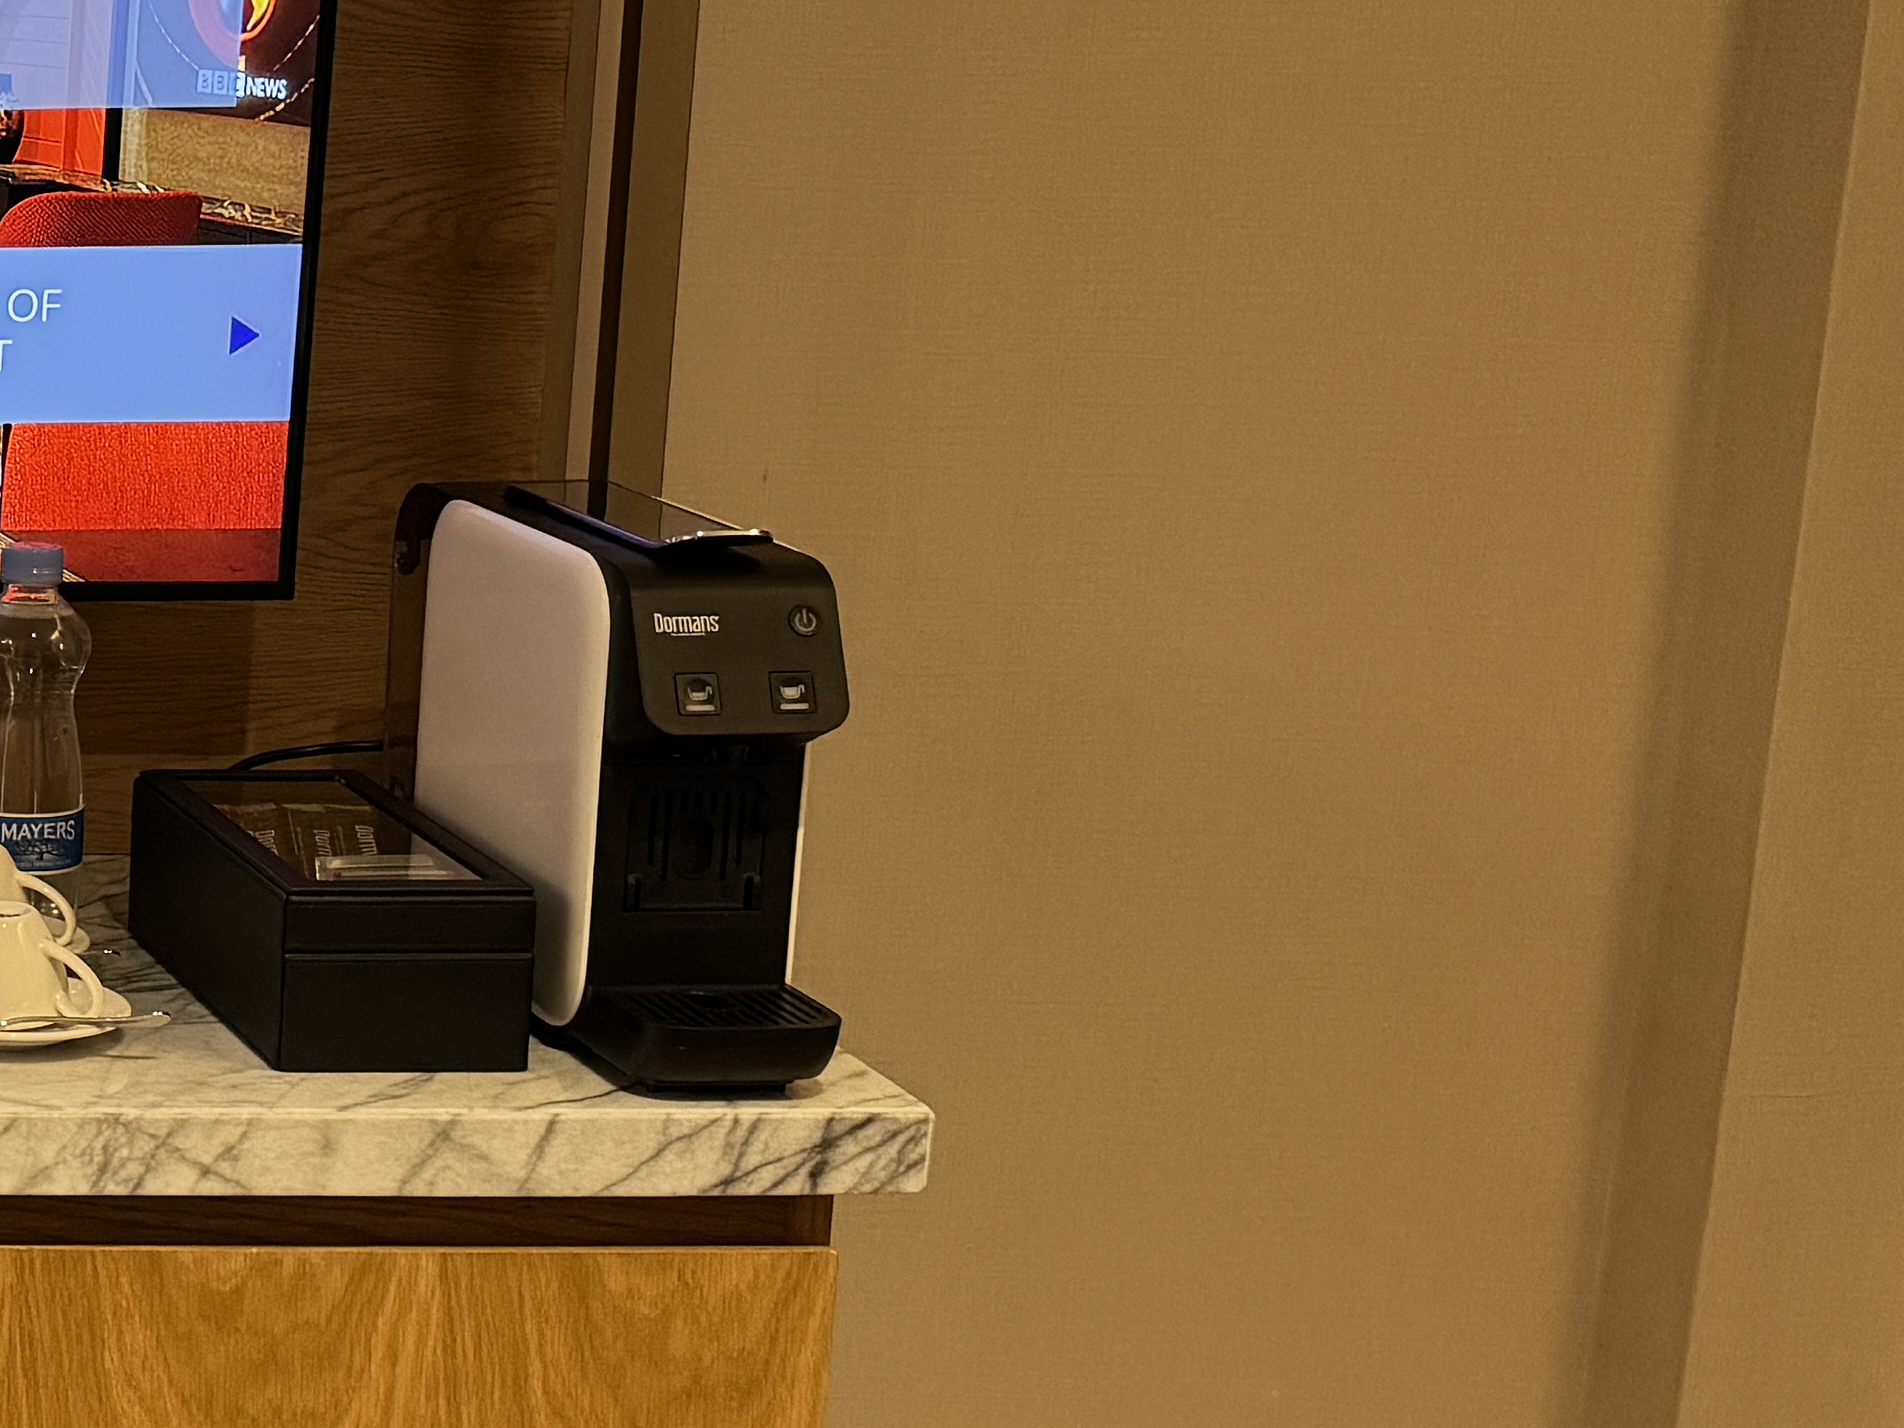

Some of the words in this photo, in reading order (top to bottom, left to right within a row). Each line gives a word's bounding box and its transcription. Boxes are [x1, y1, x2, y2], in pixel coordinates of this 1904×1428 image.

[246, 75, 288, 101] NEWS
[7, 288, 63, 322] OF
[653, 612, 720, 634] Dormans
[1, 819, 76, 843] MAYERS
